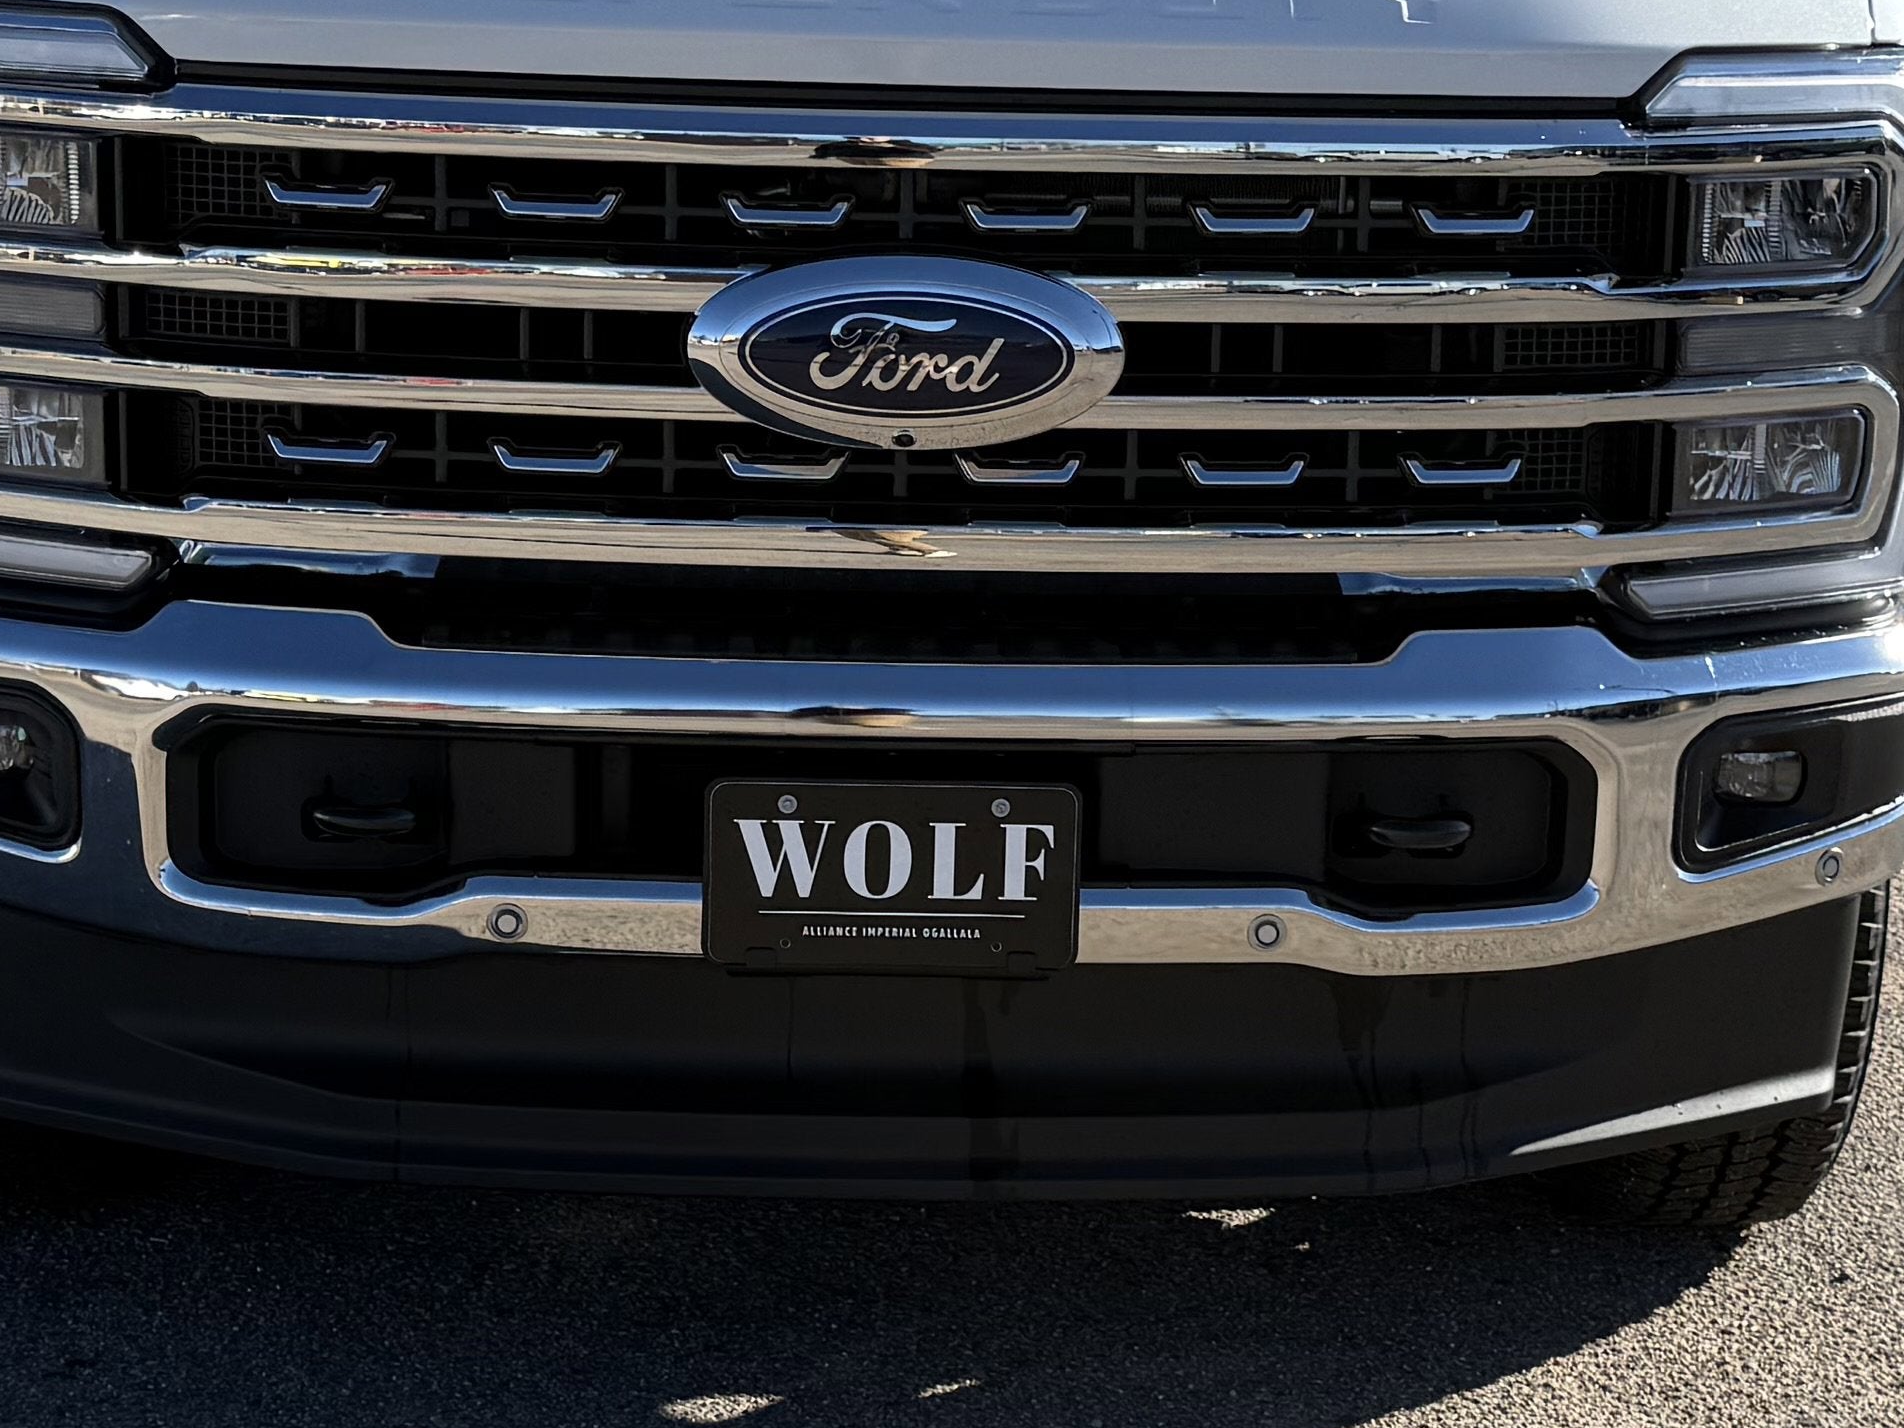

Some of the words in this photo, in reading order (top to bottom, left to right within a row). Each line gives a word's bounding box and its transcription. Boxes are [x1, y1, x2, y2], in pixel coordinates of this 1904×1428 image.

[809, 312, 1005, 394] Ford
[733, 818, 1055, 901] WOLF
[802, 925, 858, 937] ALLIANCE
[862, 926, 917, 938] IMPERIAL
[922, 927, 981, 939] OGALLALA
